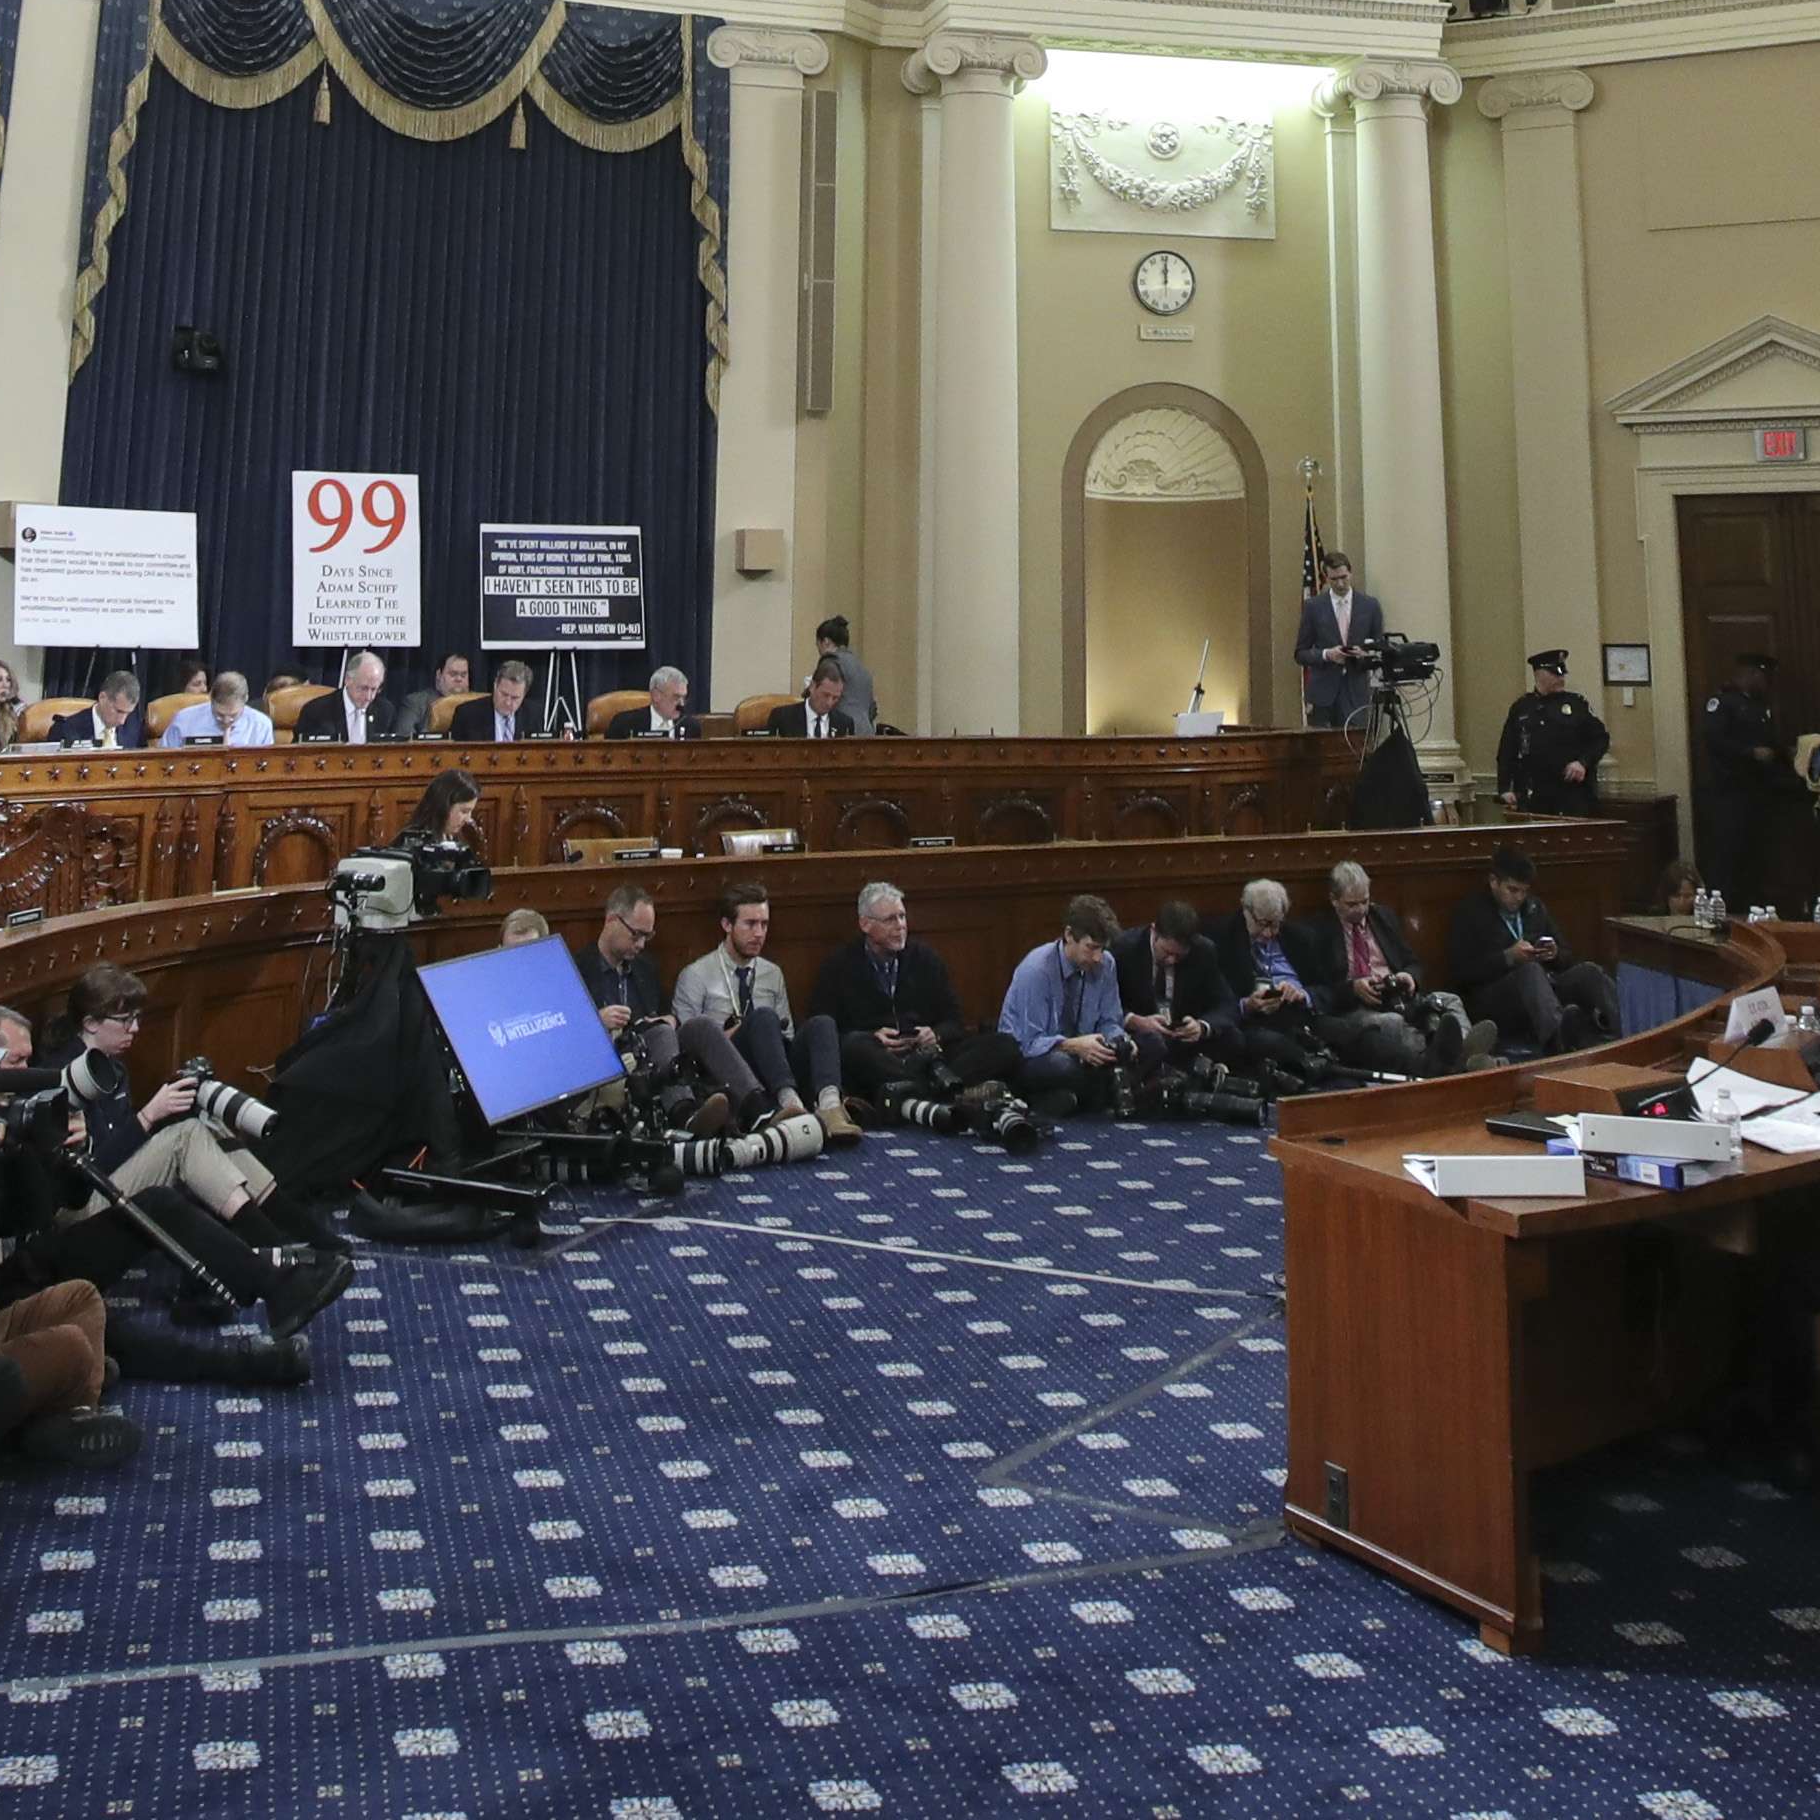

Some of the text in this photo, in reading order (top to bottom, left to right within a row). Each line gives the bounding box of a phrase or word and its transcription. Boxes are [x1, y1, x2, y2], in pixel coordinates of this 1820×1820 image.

[1764, 431, 1797, 456] EXIT
[307, 478, 406, 554] 99
[486, 579, 637, 594] I HAVEN'T SEEN THIS TO BE
[518, 601, 526, 615] A
[530, 601, 559, 615] GOOD
[561, 623, 578, 634] REP.
[579, 623, 594, 634] VAN
[594, 623, 616, 634] DREW
[617, 622, 640, 635] (D-NJ)
[505, 1012, 567, 1041] INTELLIGENCE
